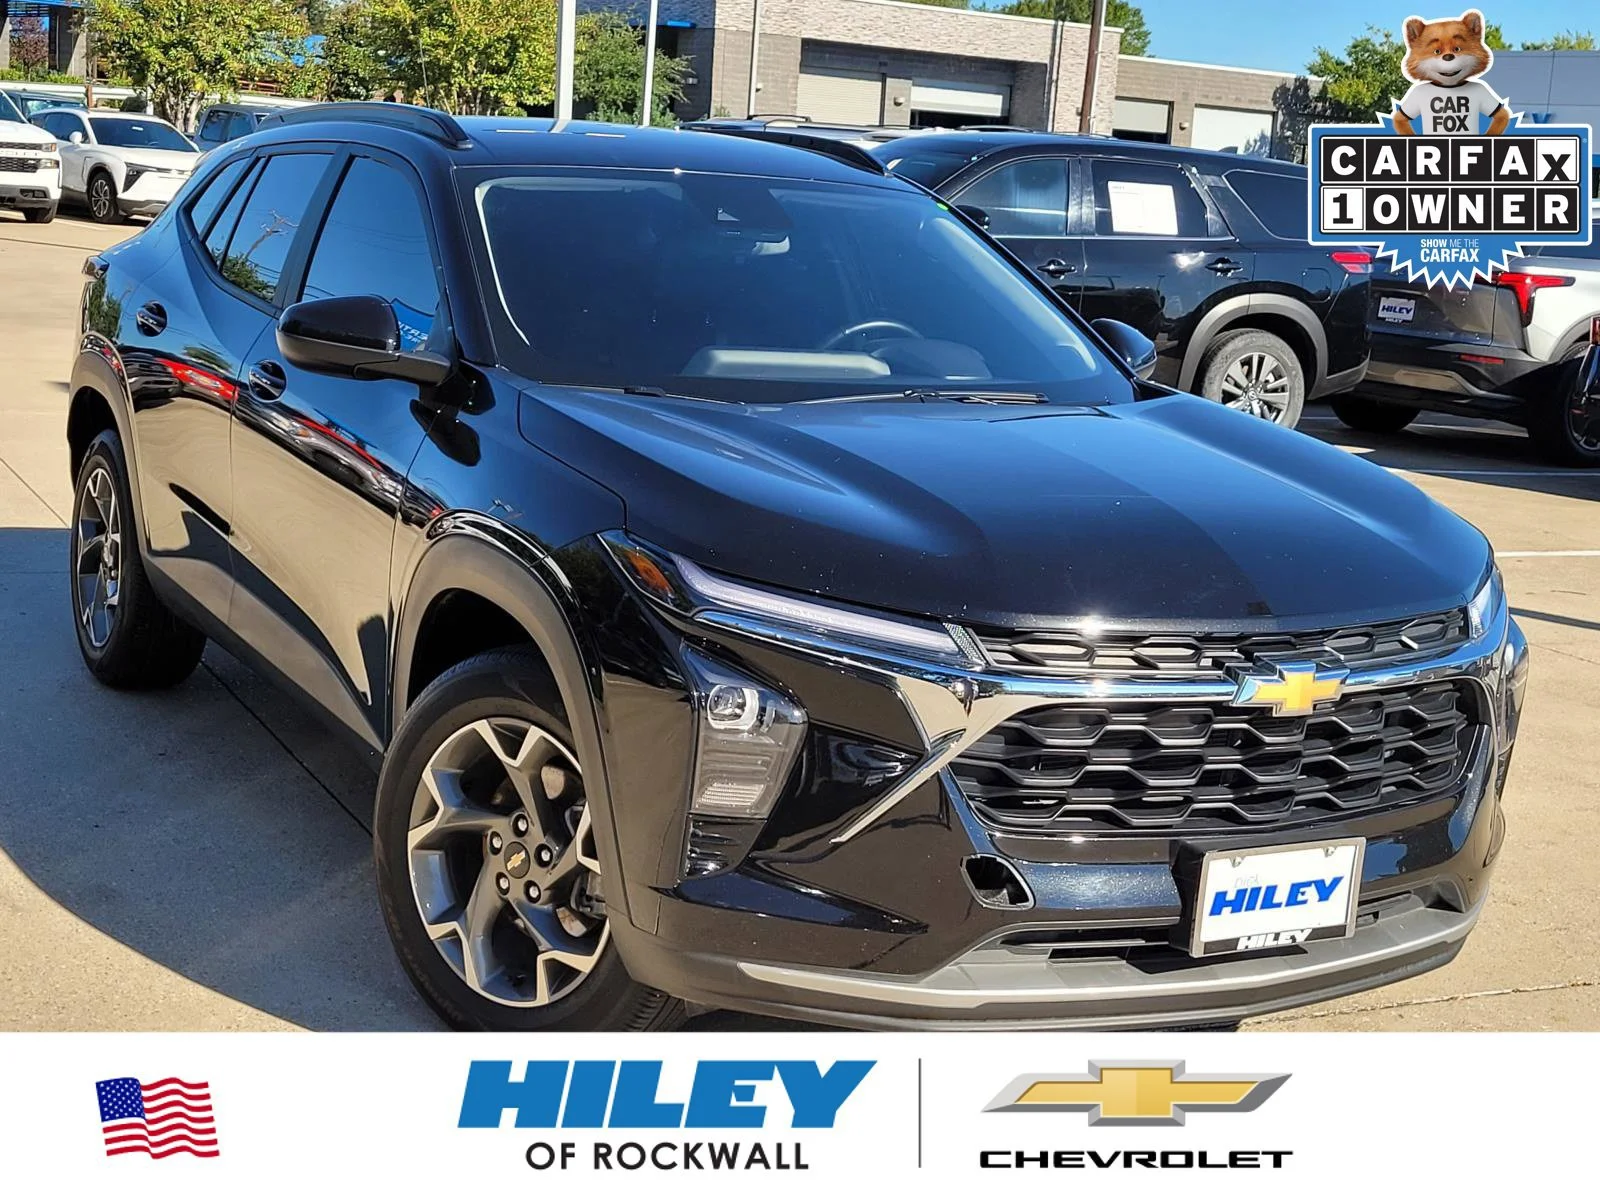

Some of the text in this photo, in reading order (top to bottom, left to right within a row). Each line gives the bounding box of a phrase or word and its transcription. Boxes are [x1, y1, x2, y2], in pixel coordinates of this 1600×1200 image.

[1381, 304, 1413, 315] HILEY
[1209, 876, 1344, 917] HILEY
[1236, 928, 1313, 950] HILEY
